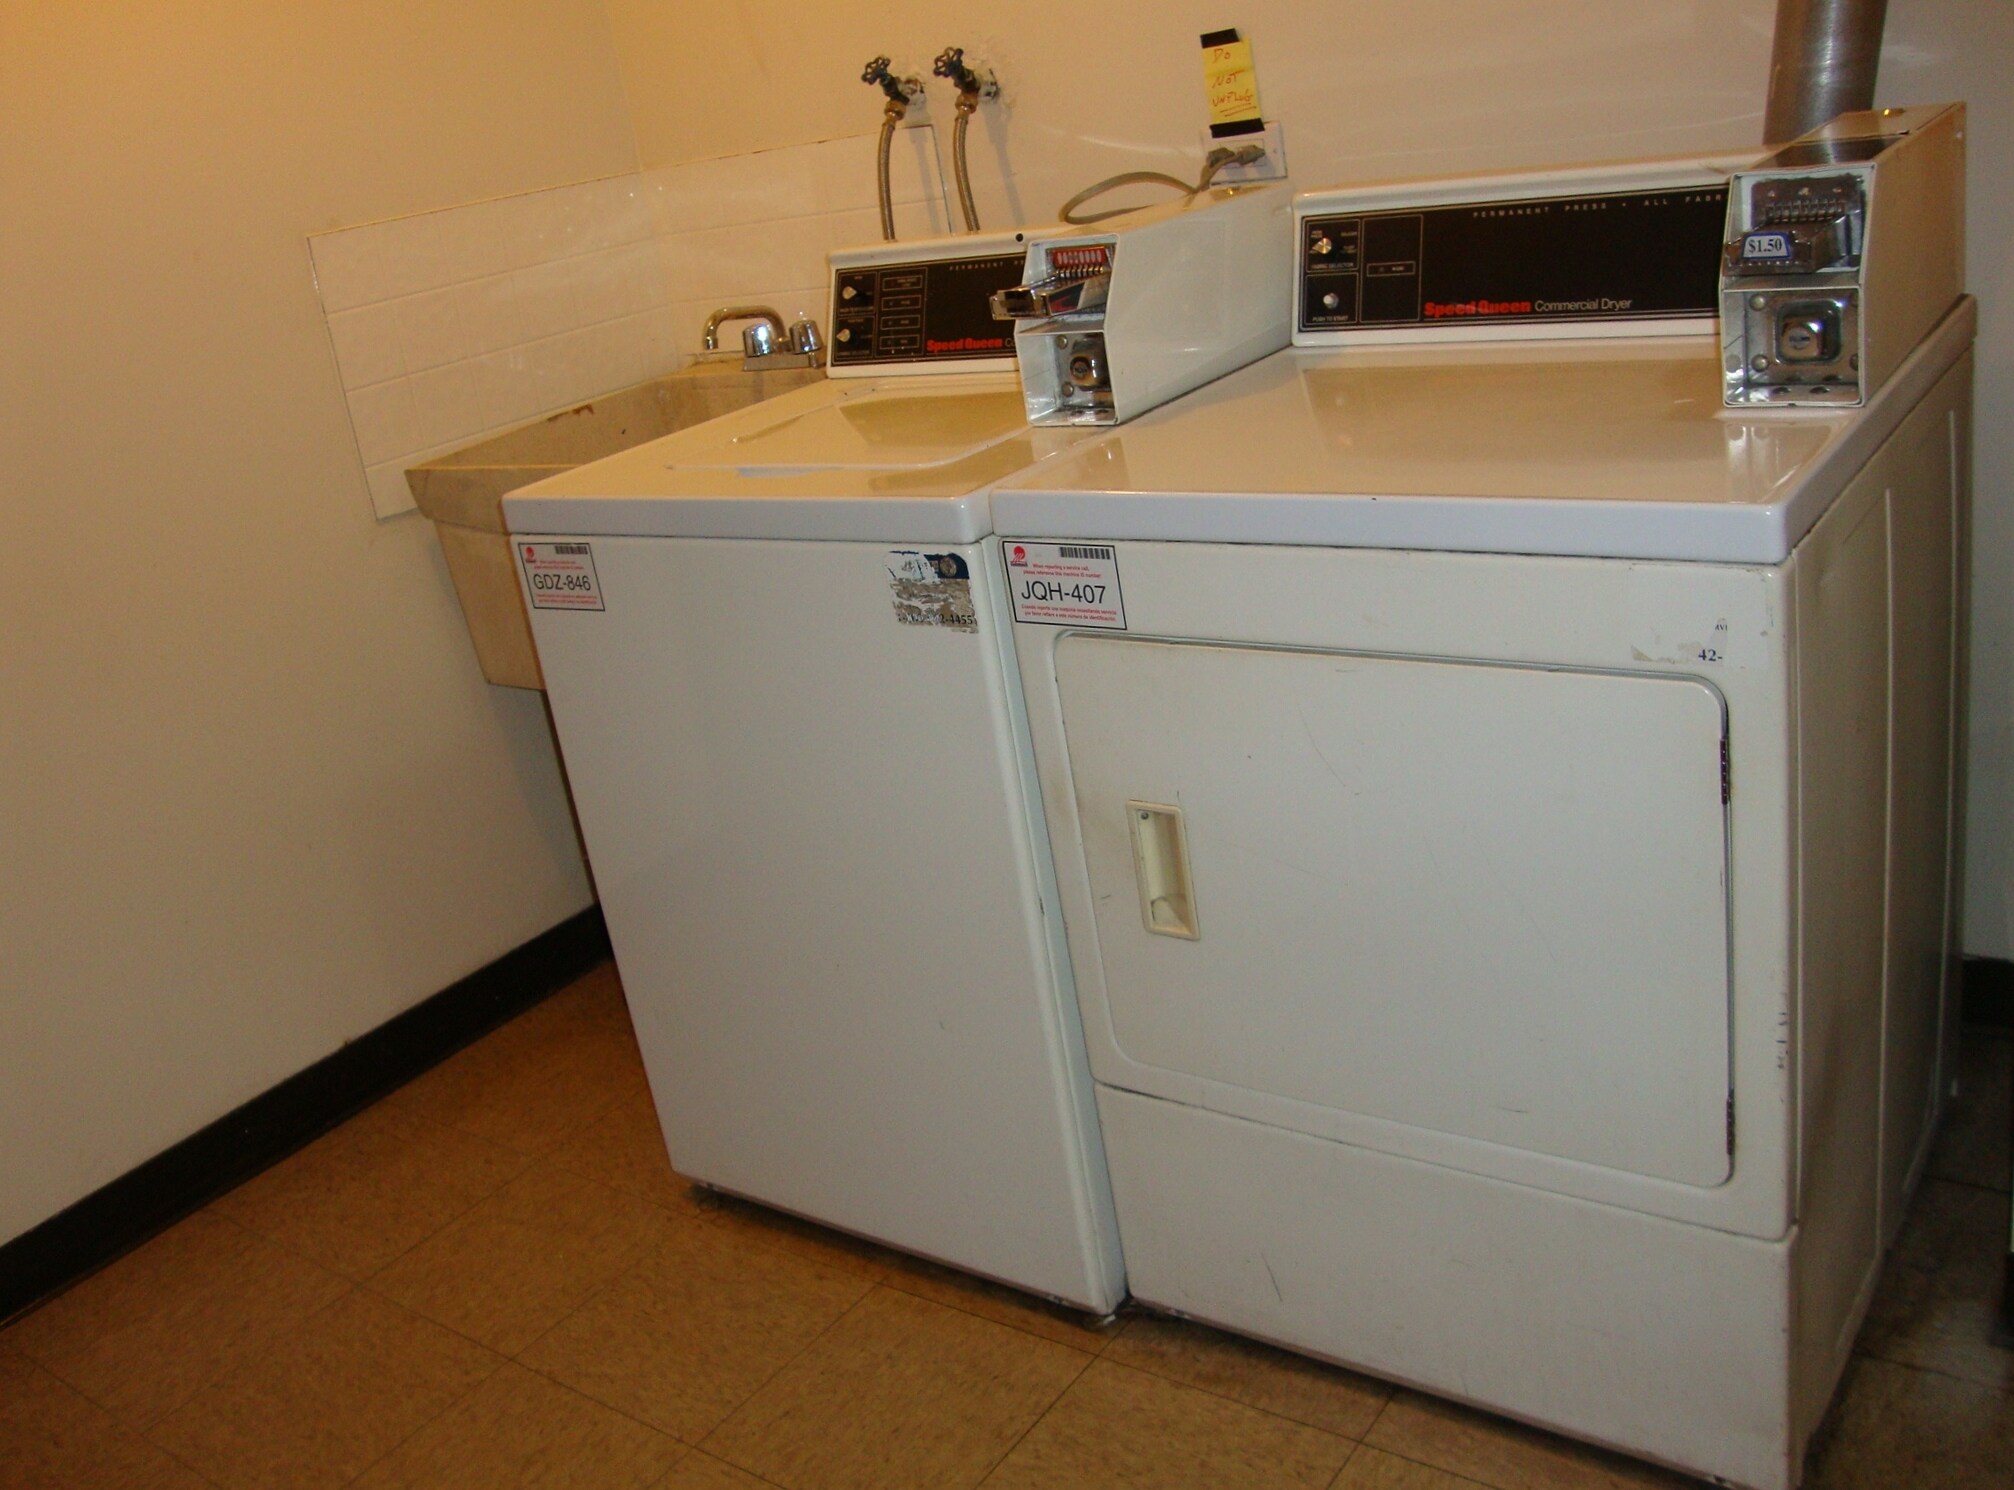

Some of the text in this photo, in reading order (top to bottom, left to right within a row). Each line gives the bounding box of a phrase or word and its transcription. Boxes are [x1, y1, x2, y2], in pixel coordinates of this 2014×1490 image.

[1473, 207, 1550, 218] PERMANENT
[1564, 202, 1607, 212] PRESS
[1643, 199, 1668, 207] ALL
[1748, 238, 1783, 253] $1.50
[1424, 298, 1632, 318] Speed Queen Commercial Dryer
[926, 340, 963, 354] Speed
[965, 338, 1003, 349] Queen
[533, 573, 591, 591] GDZ-846
[1021, 581, 1106, 604] JQH-407
